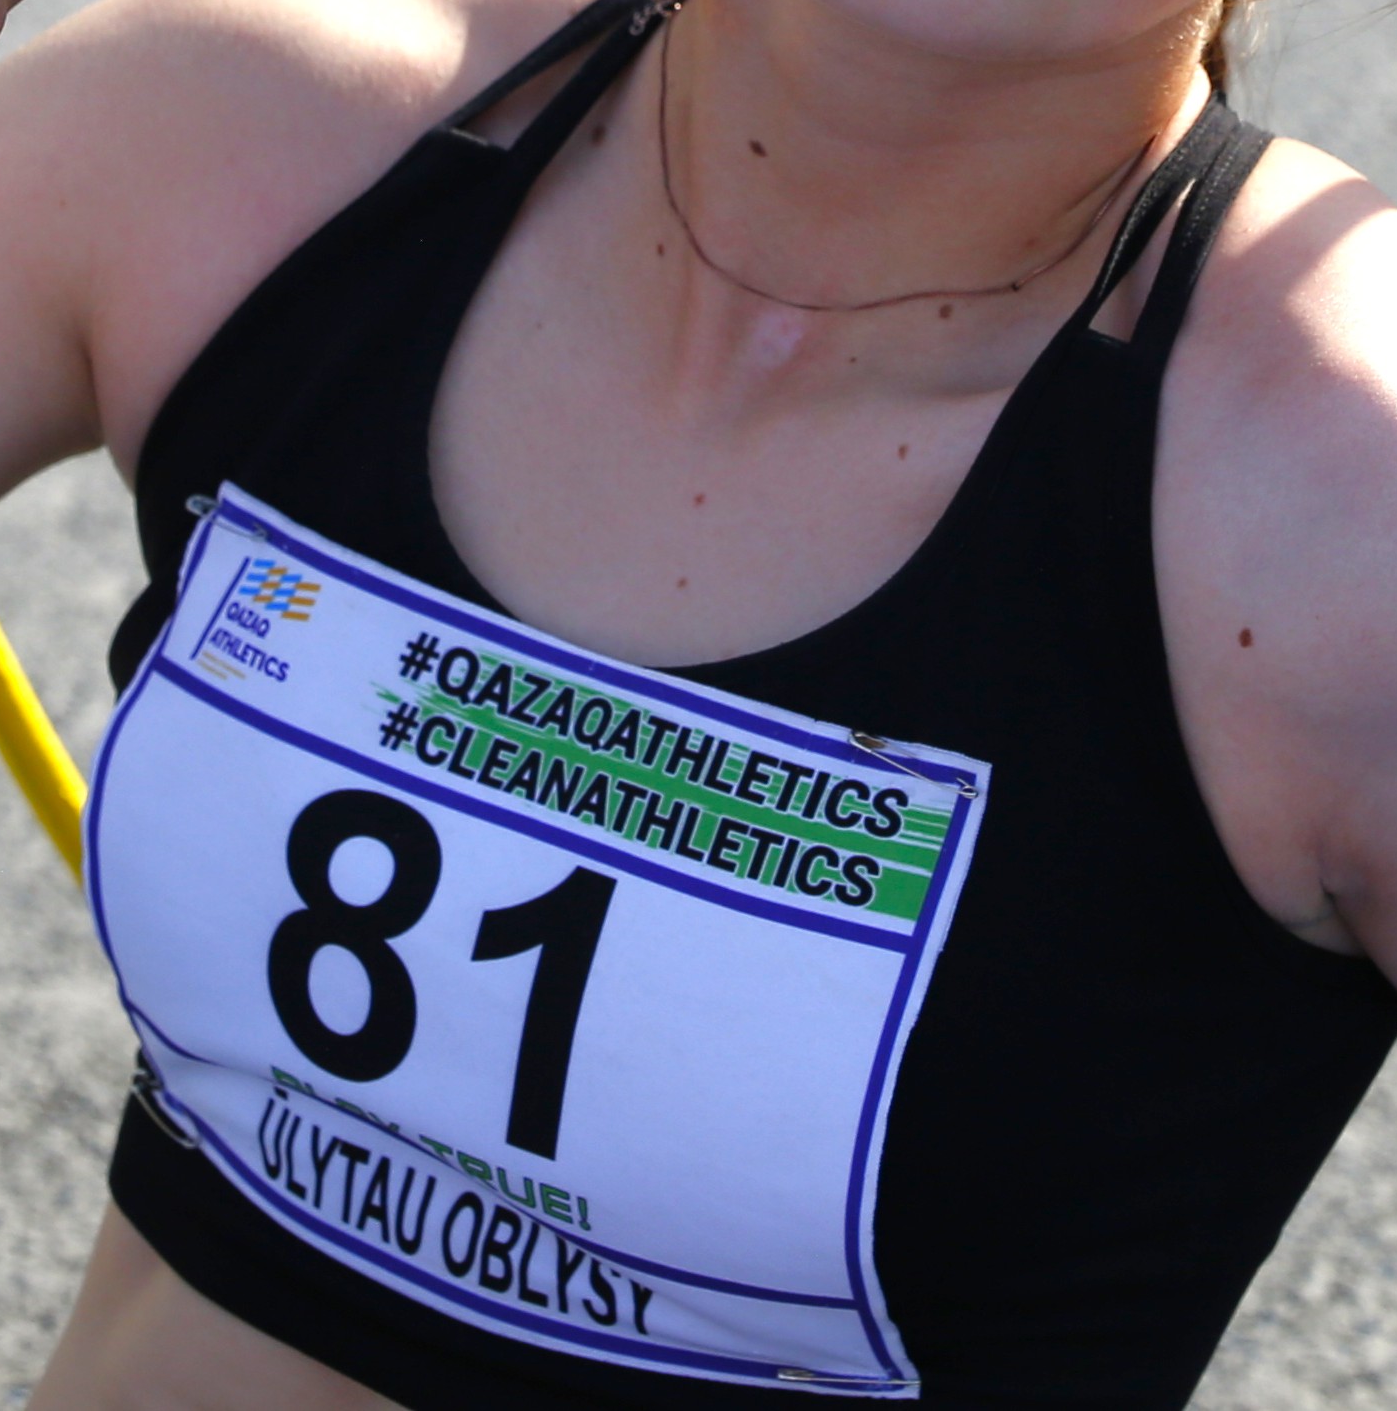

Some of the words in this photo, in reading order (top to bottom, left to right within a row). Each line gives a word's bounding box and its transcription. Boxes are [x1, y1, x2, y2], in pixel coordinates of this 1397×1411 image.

[210, 628, 290, 681] ATHLETICS
[399, 632, 909, 839] #QAZAQATHLETICS
[379, 702, 883, 908] #CLEANATHLETICS
[267, 788, 618, 1161] 81
[441, 1191, 654, 1335] OBLYSY
